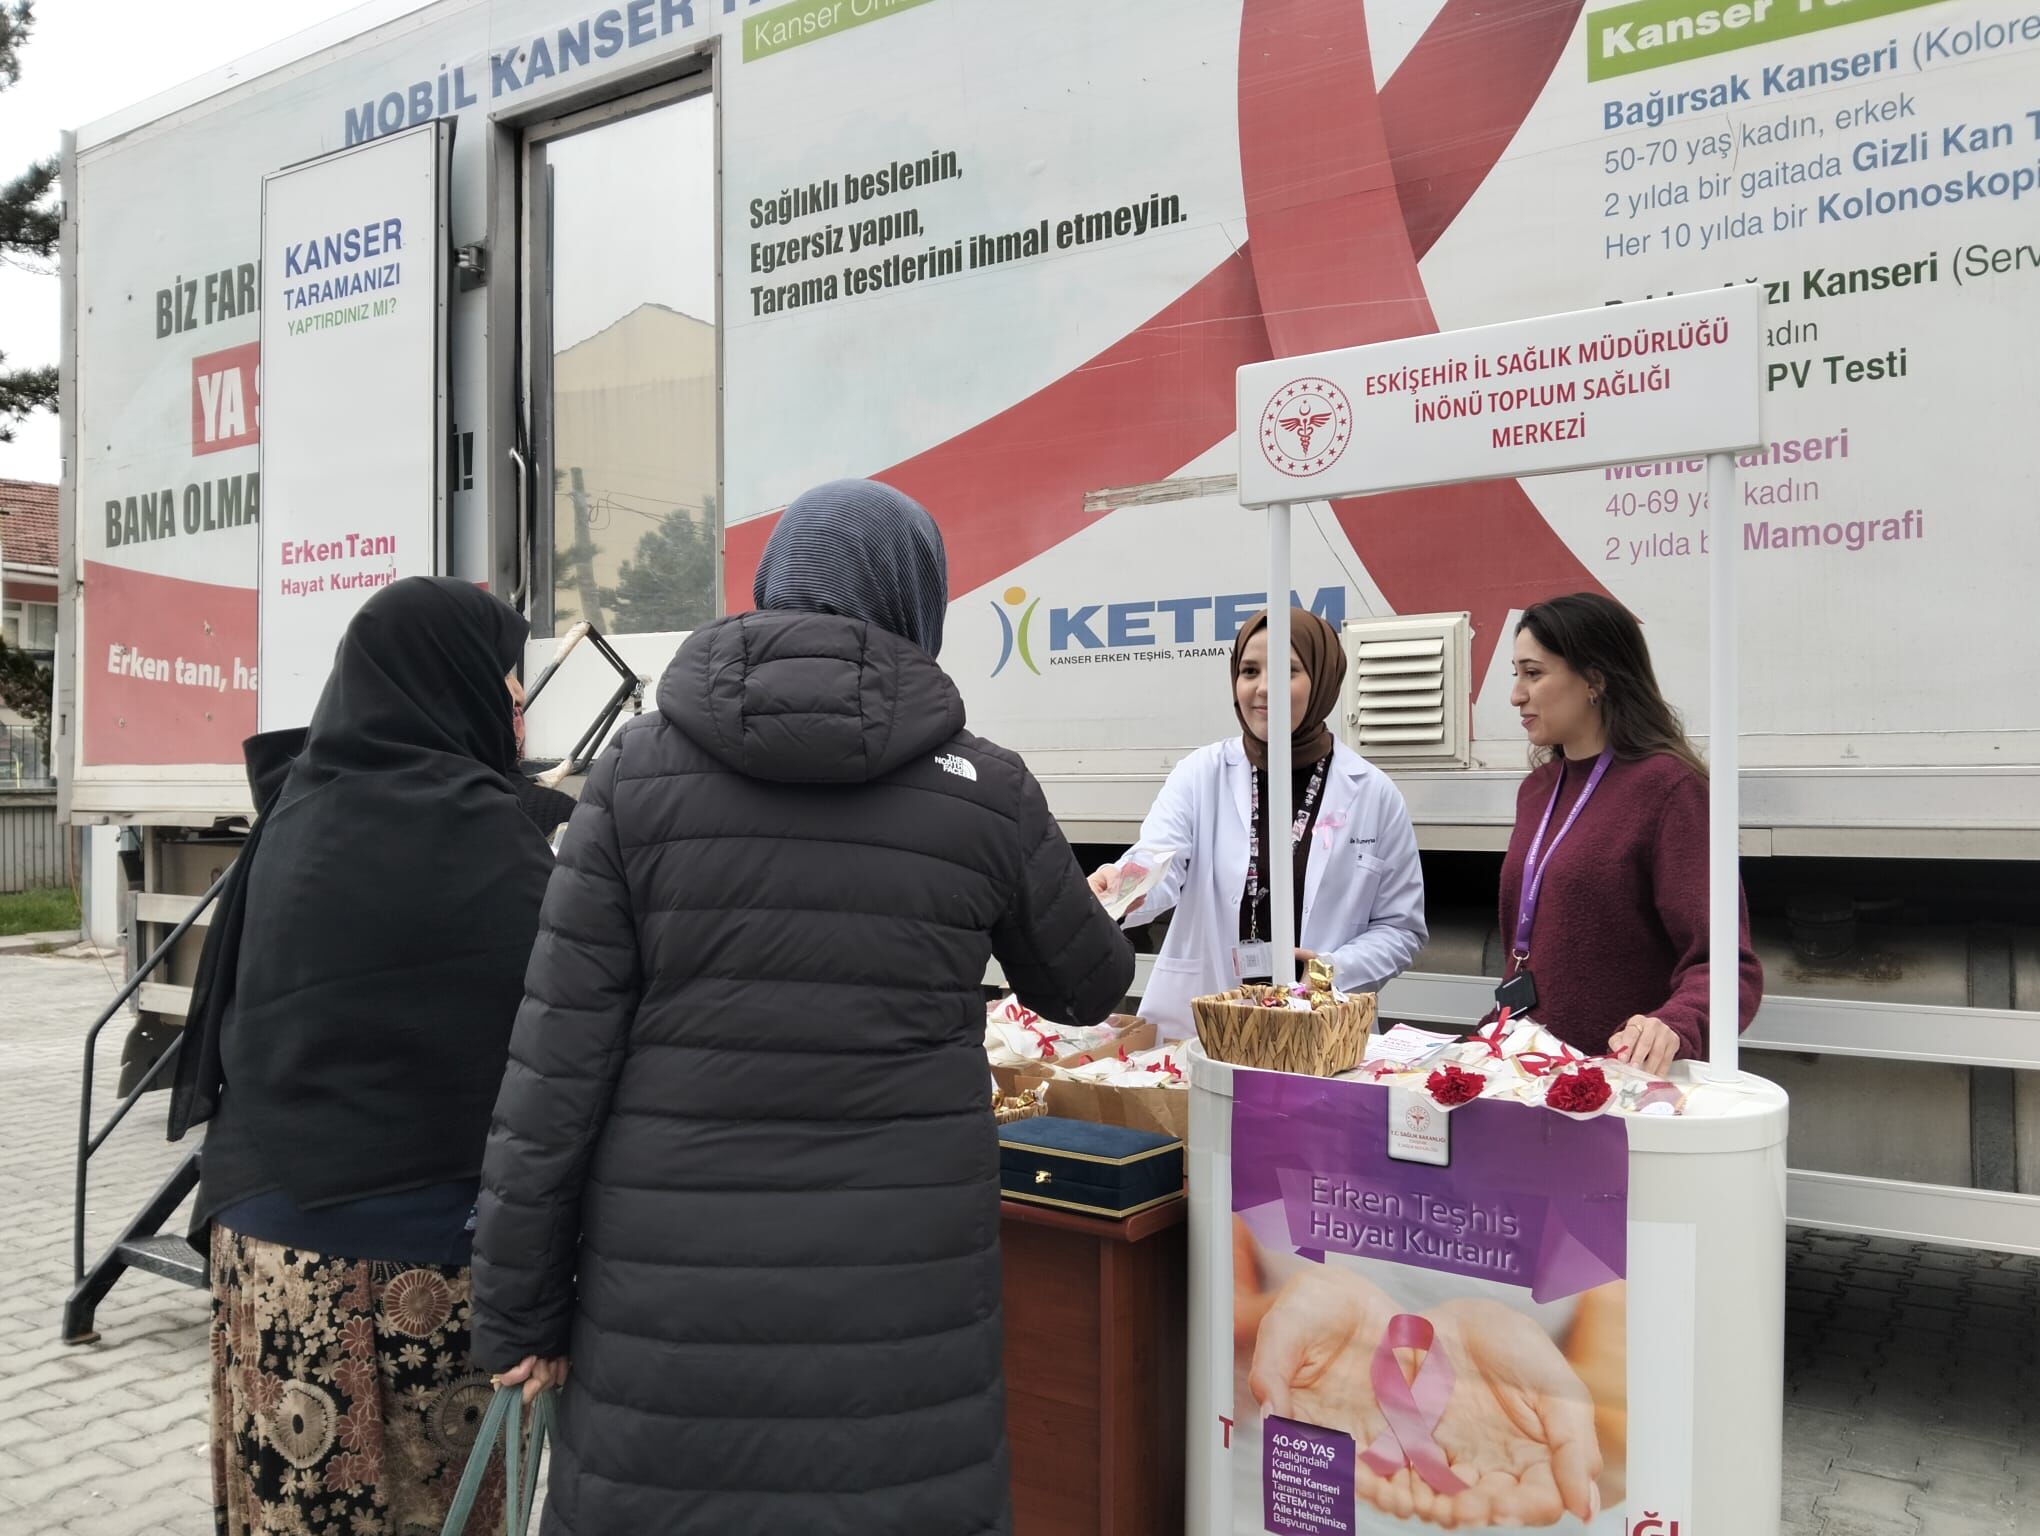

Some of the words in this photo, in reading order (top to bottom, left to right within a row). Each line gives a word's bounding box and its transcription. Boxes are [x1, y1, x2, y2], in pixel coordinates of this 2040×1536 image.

[755, 2, 842, 50] Kanser
[1602, 0, 1773, 58] Kanser
[345, 63, 477, 147] MOBİL
[491, 0, 694, 98] KANSER
[1604, 74, 1750, 130] Bağırsak
[1763, 39, 1898, 96] Kanseri
[1604, 138, 1678, 174] 50-70
[1686, 130, 1733, 165] yaş
[1742, 113, 1825, 149] kadın,
[1836, 92, 1916, 131] erkek
[750, 181, 838, 229] Sağlıklı
[845, 149, 963, 205] beslenin,
[1604, 193, 1619, 217] 2
[1628, 182, 1688, 220] yılda
[1699, 173, 1732, 200] bir
[1740, 154, 1841, 198] gaitada
[1853, 131, 1928, 172] Gizli
[1943, 123, 2013, 156] Kan
[285, 217, 403, 279] KANSER
[750, 225, 843, 274] Egzersiz
[849, 207, 925, 252] yapın,
[750, 274, 838, 316] Tarama
[843, 240, 962, 296] testlerini
[970, 220, 1048, 269] ihmal
[1056, 193, 1188, 250] etmeyin.
[1606, 231, 1651, 259] Her
[1662, 222, 1690, 249] 10
[1700, 213, 1763, 250] yılda
[1773, 202, 1807, 231] bir
[283, 262, 401, 311] TARAMANIZI
[1803, 252, 1938, 301] Kanseri
[156, 275, 198, 339] BİZ
[288, 303, 369, 337] YAPTIRDINIZ
[1366, 356, 1469, 396] ESKİŞEHİR
[1474, 352, 1492, 381] İL
[1497, 344, 1572, 376] SAĞLIK
[1578, 317, 1730, 364] MÜDÜRLÜĞÜ
[1823, 347, 1907, 385] Testi
[197, 367, 247, 443] YA
[1414, 388, 1484, 424] İNÖNÜ
[1488, 384, 1577, 414] TOPLUM
[1583, 364, 1671, 400] SAĞLIĞI
[1491, 411, 1586, 449] MERKEZİ
[105, 489, 176, 548] BANA
[1606, 488, 1679, 518] 40-69
[1744, 477, 1820, 506] kadın
[281, 540, 343, 565] Erken
[346, 533, 396, 558] Tanı
[1605, 536, 1620, 561] 2
[1629, 532, 1691, 565] yılda
[1743, 510, 1924, 551] Mamografi
[281, 575, 324, 597] Hayat
[107, 645, 168, 683] Erken
[175, 656, 226, 693] tanı,
[1050, 655, 1092, 665] KANSER
[1094, 653, 1131, 663] ERKEN
[1133, 650, 1175, 662] TEŞHİS,
[1177, 647, 1225, 658] TARAMA
[1310, 1175, 1402, 1218] Erken
[1410, 1190, 1519, 1236] Teşhis
[1309, 1210, 1394, 1250] Hayat
[1402, 1226, 1520, 1273] Kurtarır.
[1272, 1433, 1308, 1451] 40-69
[1310, 1442, 1335, 1461] YAŞ
[1272, 1448, 1329, 1469] Aralığındaki
[1272, 1458, 1311, 1476] Kadınlar
[1272, 1469, 1302, 1485] Meme
[1303, 1478, 1340, 1495] Kanseri
[1272, 1480, 1315, 1499] Taraması
[1317, 1492, 1334, 1505] için
[1273, 1491, 1307, 1508] KETEM
[1308, 1502, 1331, 1515] veya
[1273, 1502, 1292, 1515] Aile
[1293, 1509, 1347, 1531] Hekiminize
[1273, 1512, 1320, 1535] Başvurun.
